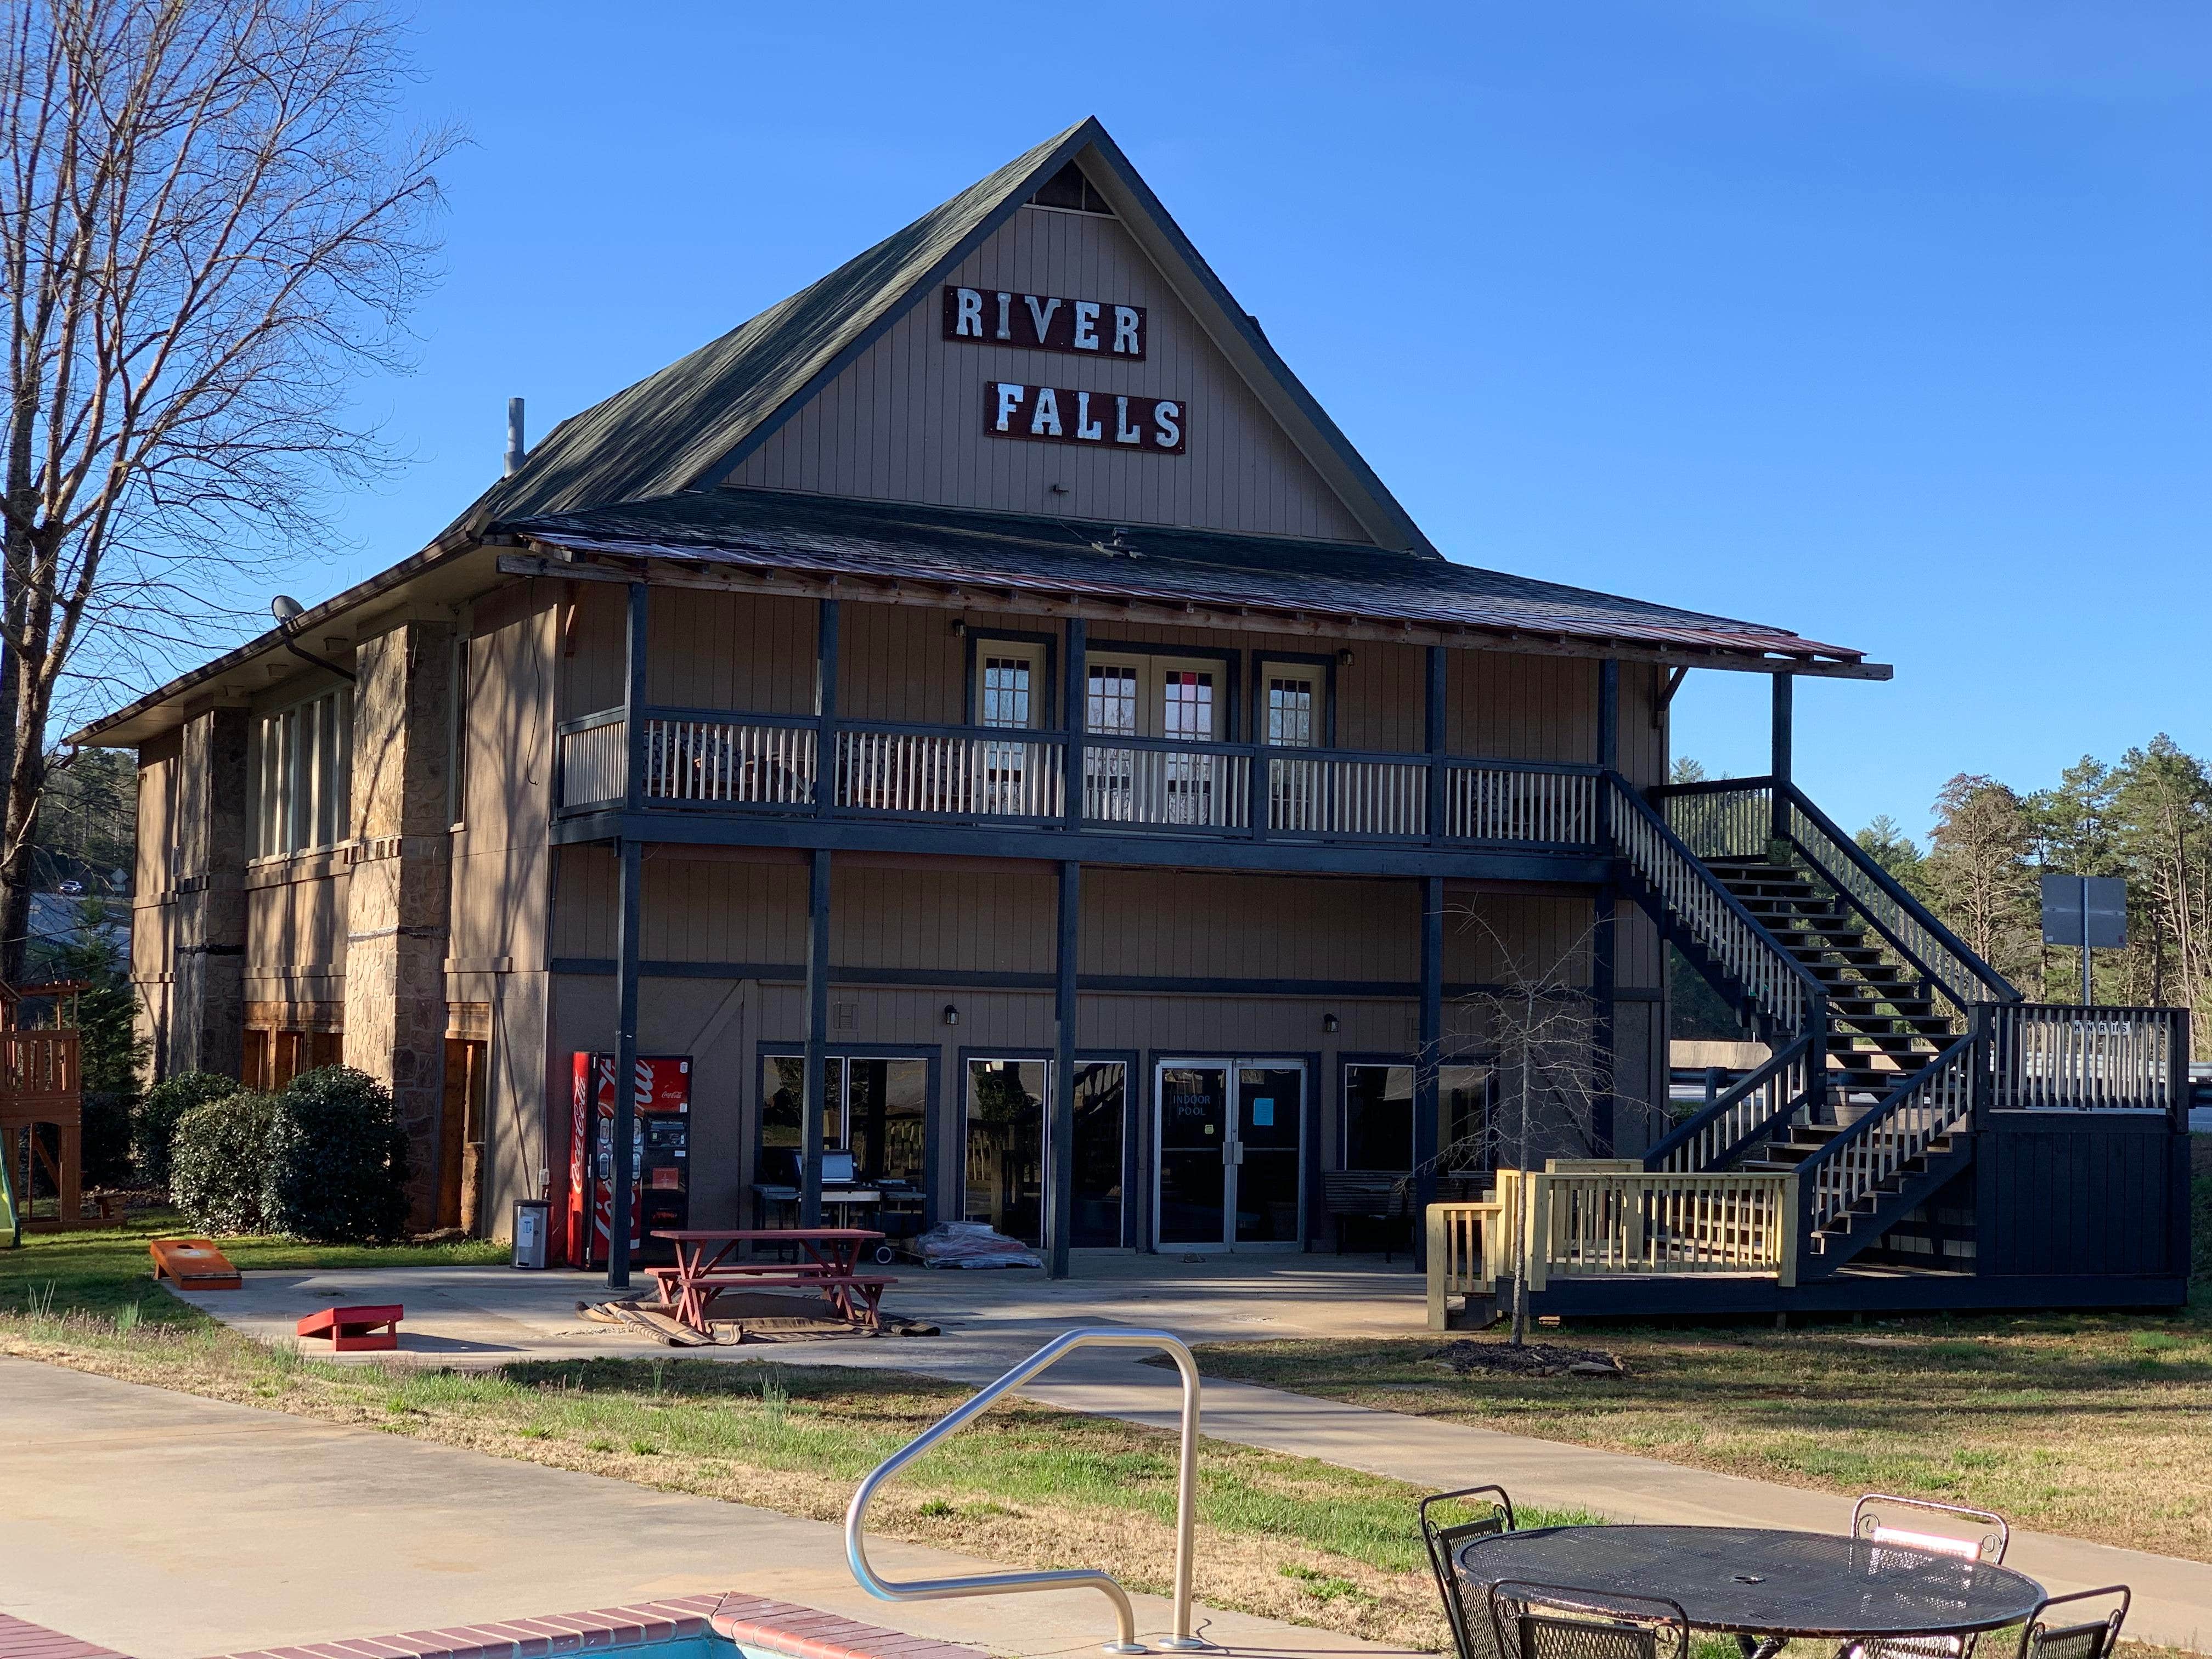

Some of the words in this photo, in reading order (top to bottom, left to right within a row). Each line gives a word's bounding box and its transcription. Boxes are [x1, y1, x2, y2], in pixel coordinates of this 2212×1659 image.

[956, 288, 1139, 354] RIVER
[996, 383, 1180, 447] FALLS
[1173, 1094, 1210, 1104] INDOOR
